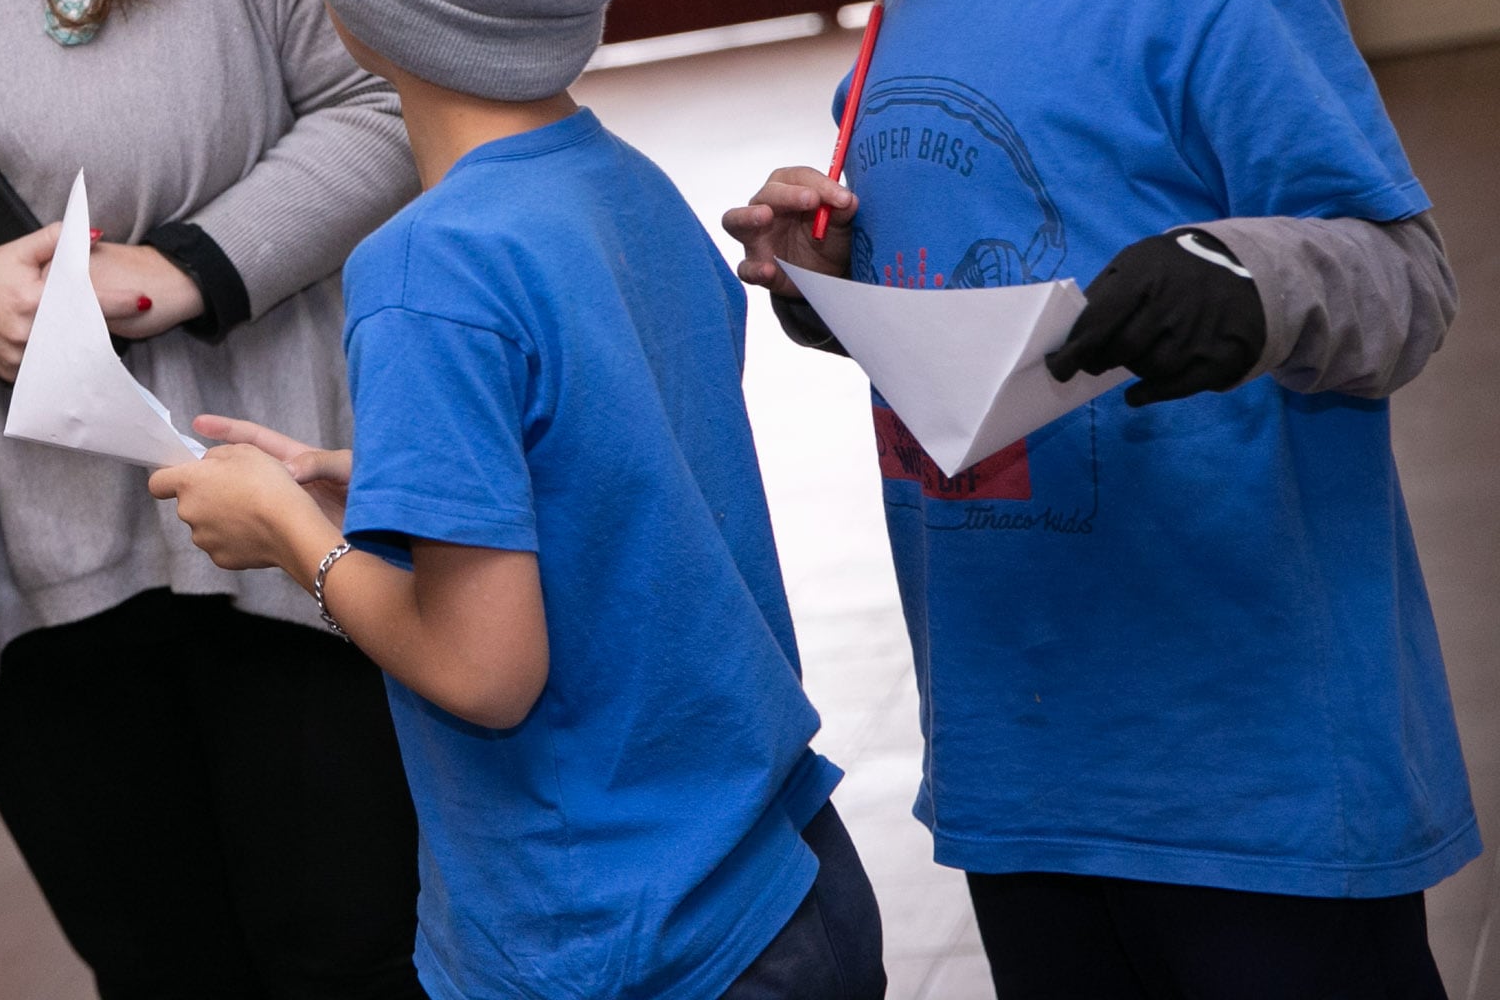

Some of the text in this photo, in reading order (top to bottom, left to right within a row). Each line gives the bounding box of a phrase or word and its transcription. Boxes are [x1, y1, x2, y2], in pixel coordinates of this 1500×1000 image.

[858, 126, 910, 173] SUPER
[917, 127, 979, 177] BASS
[1043, 507, 1093, 534] kids
